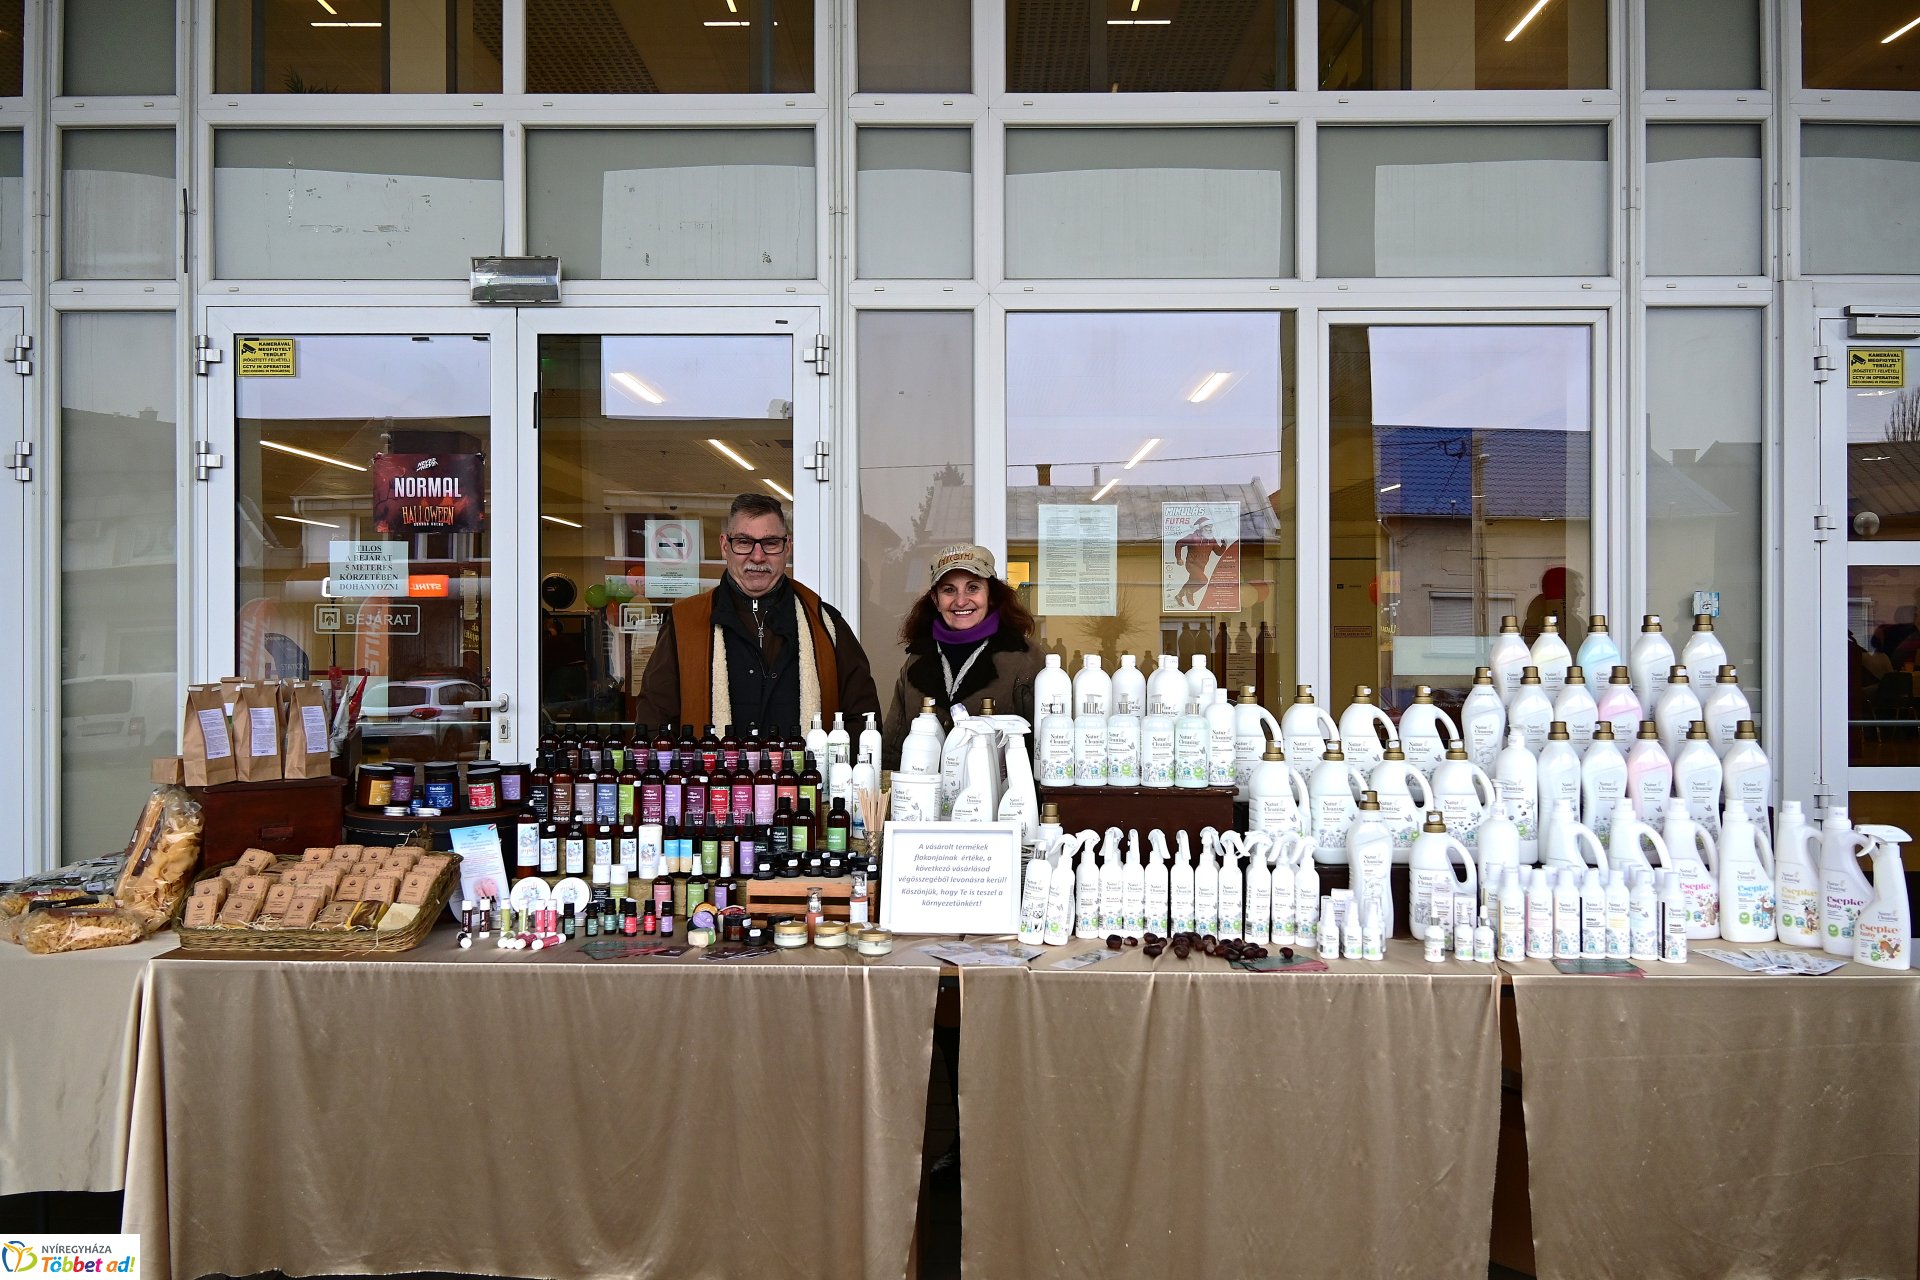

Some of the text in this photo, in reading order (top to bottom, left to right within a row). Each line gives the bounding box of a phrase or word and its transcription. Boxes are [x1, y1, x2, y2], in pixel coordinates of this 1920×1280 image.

[394, 478, 462, 498] NORMAL
[402, 506, 454, 525] HALLOWEEN
[340, 572, 398, 580] KÖRZETÉBEN
[340, 582, 398, 590] DOHÁNYOZNI
[345, 609, 411, 625] BEJÁRAT
[914, 854, 957, 862] flakonjainak
